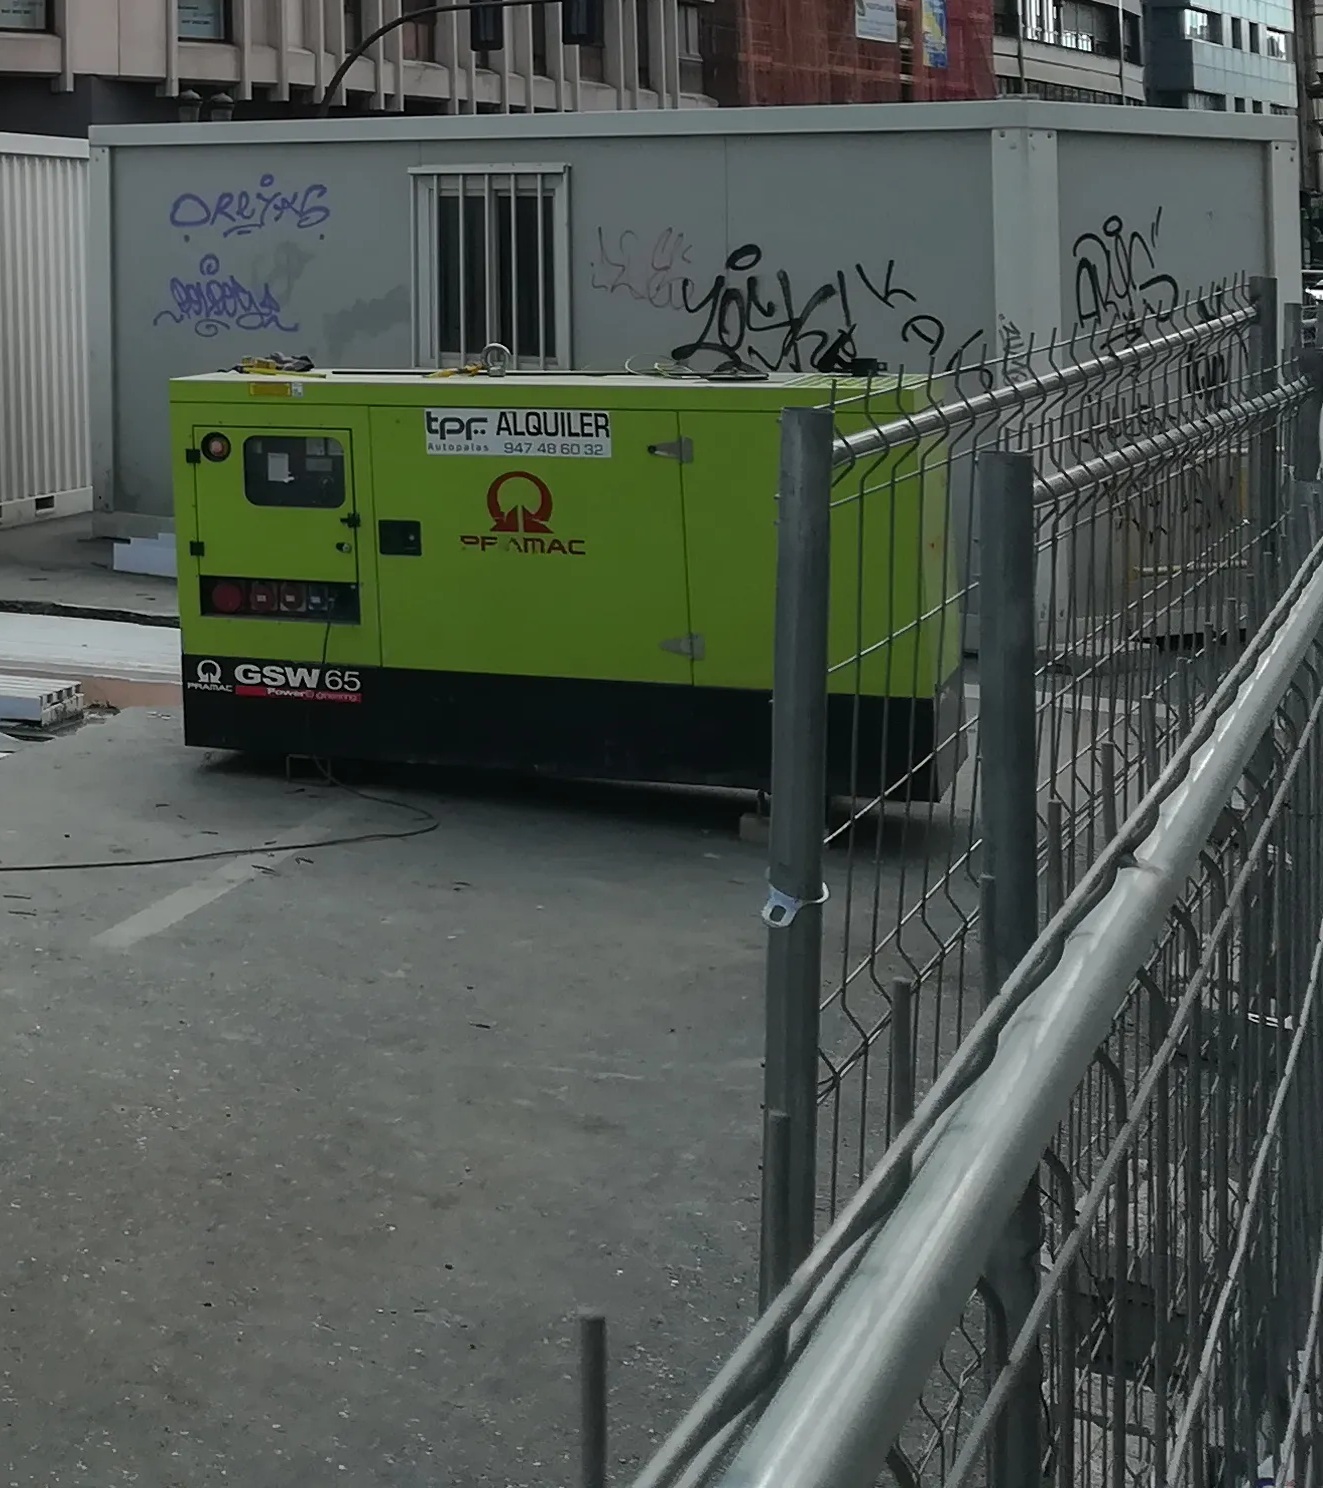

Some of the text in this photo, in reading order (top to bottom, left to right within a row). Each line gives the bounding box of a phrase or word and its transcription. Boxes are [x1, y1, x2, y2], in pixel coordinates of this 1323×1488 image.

[496, 411, 611, 439] ALQUILER
[427, 441, 604, 456] Autopalas 947 48 60 32
[187, 681, 234, 694] PRAMAC
[234, 663, 362, 692] GSW 65
